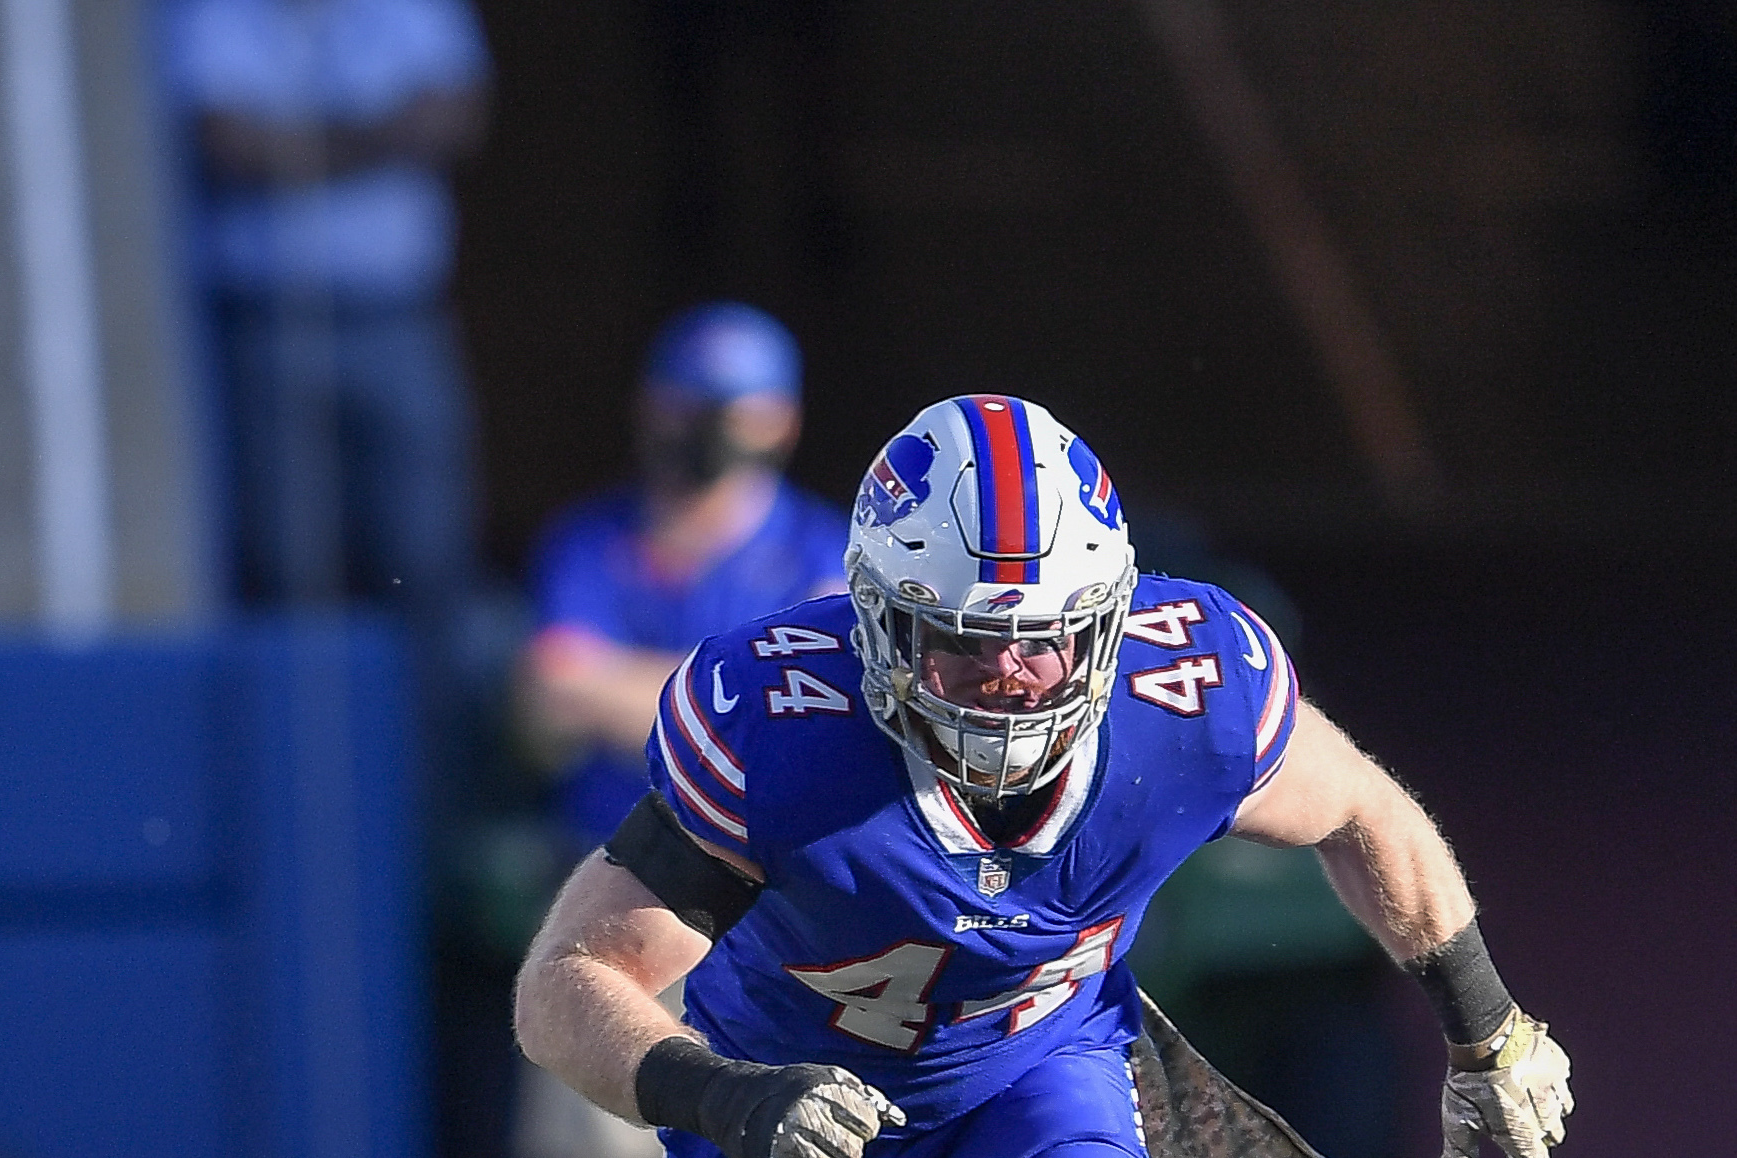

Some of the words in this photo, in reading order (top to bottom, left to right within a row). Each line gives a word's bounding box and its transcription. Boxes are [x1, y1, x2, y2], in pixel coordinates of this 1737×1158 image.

[751, 625, 852, 717] 44
[1122, 598, 1223, 718] 44
[953, 913, 1030, 933] BILLS
[782, 915, 1125, 1053] 44
